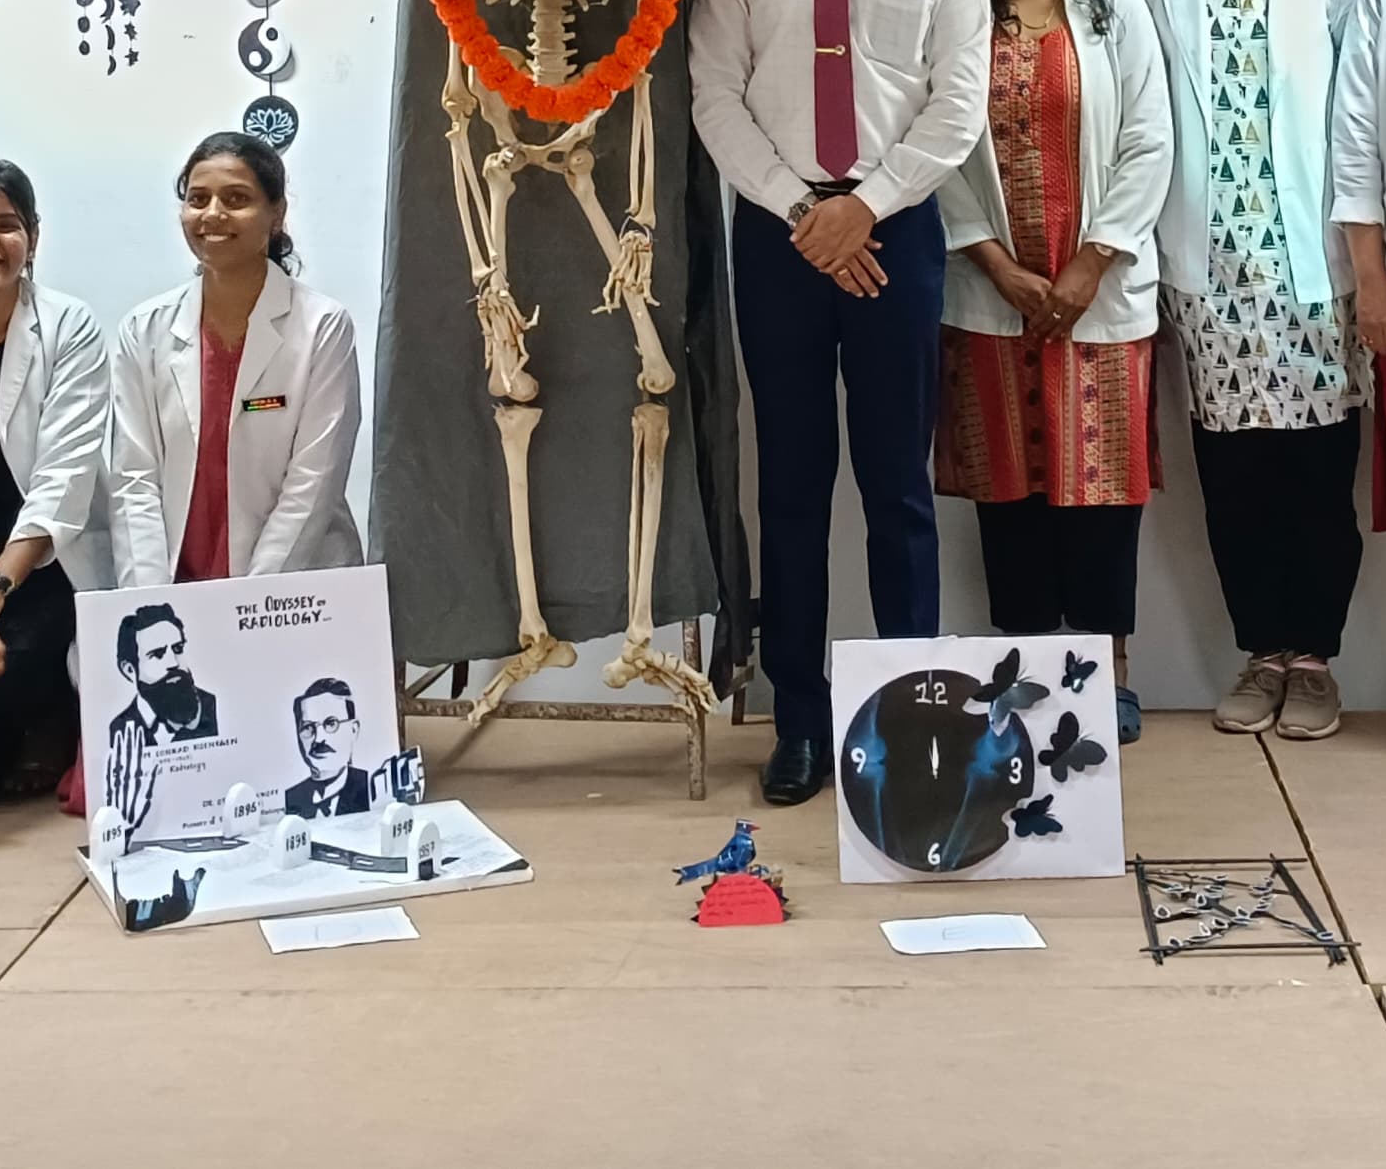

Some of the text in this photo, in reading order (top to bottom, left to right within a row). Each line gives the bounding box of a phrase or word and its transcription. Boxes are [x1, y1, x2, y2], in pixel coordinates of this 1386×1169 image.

[236, 604, 258, 615] THE
[265, 595, 315, 612] ODYSSEY
[915, 682, 949, 705] 12
[851, 747, 867, 774] 9
[1009, 757, 1023, 785] 3
[103, 825, 122, 842] 1895
[286, 832, 307, 851] 1898
[928, 843, 942, 865] 6
